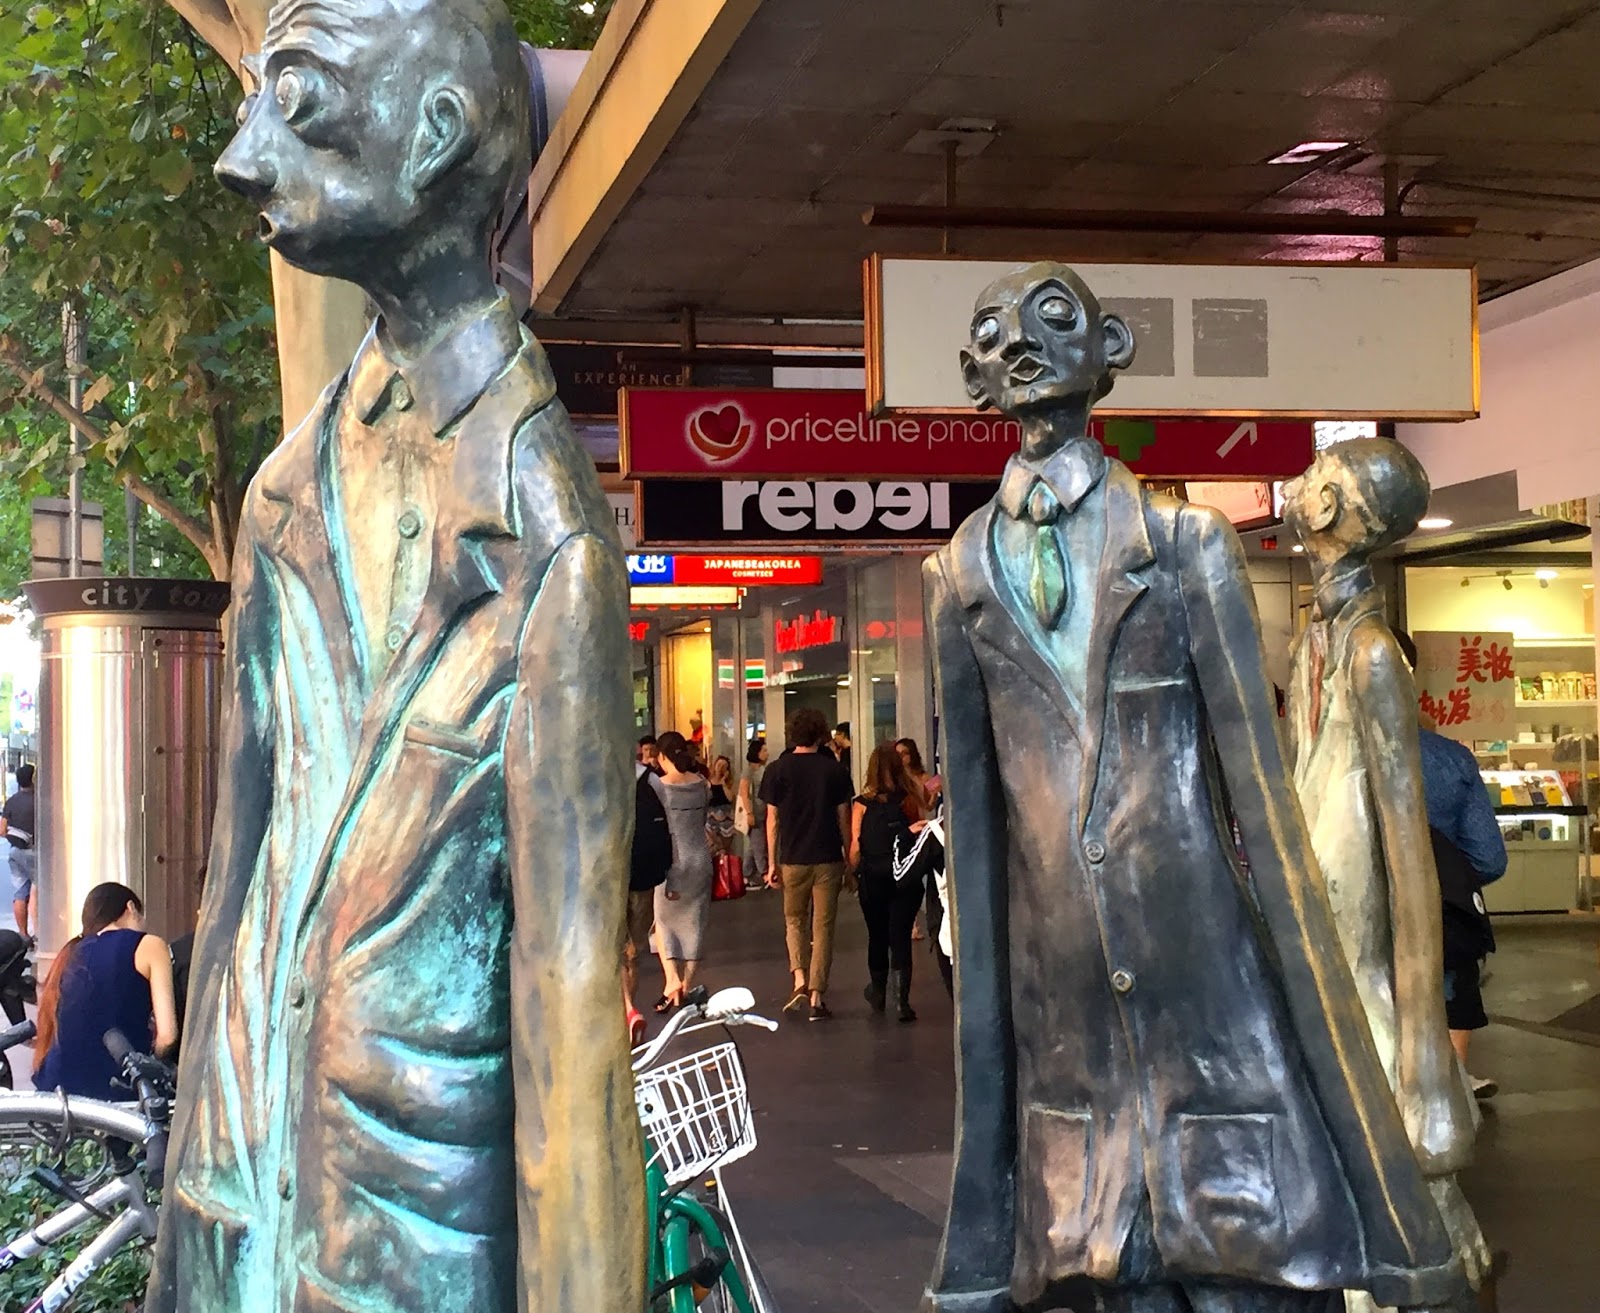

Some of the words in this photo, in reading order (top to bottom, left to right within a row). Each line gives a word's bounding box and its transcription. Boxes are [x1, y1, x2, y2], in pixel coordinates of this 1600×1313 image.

[574, 372, 684, 386] EXPERIENCE
[766, 412, 921, 450] priceline
[81, 581, 152, 610] city
[1456, 635, 1515, 683] 美妆
